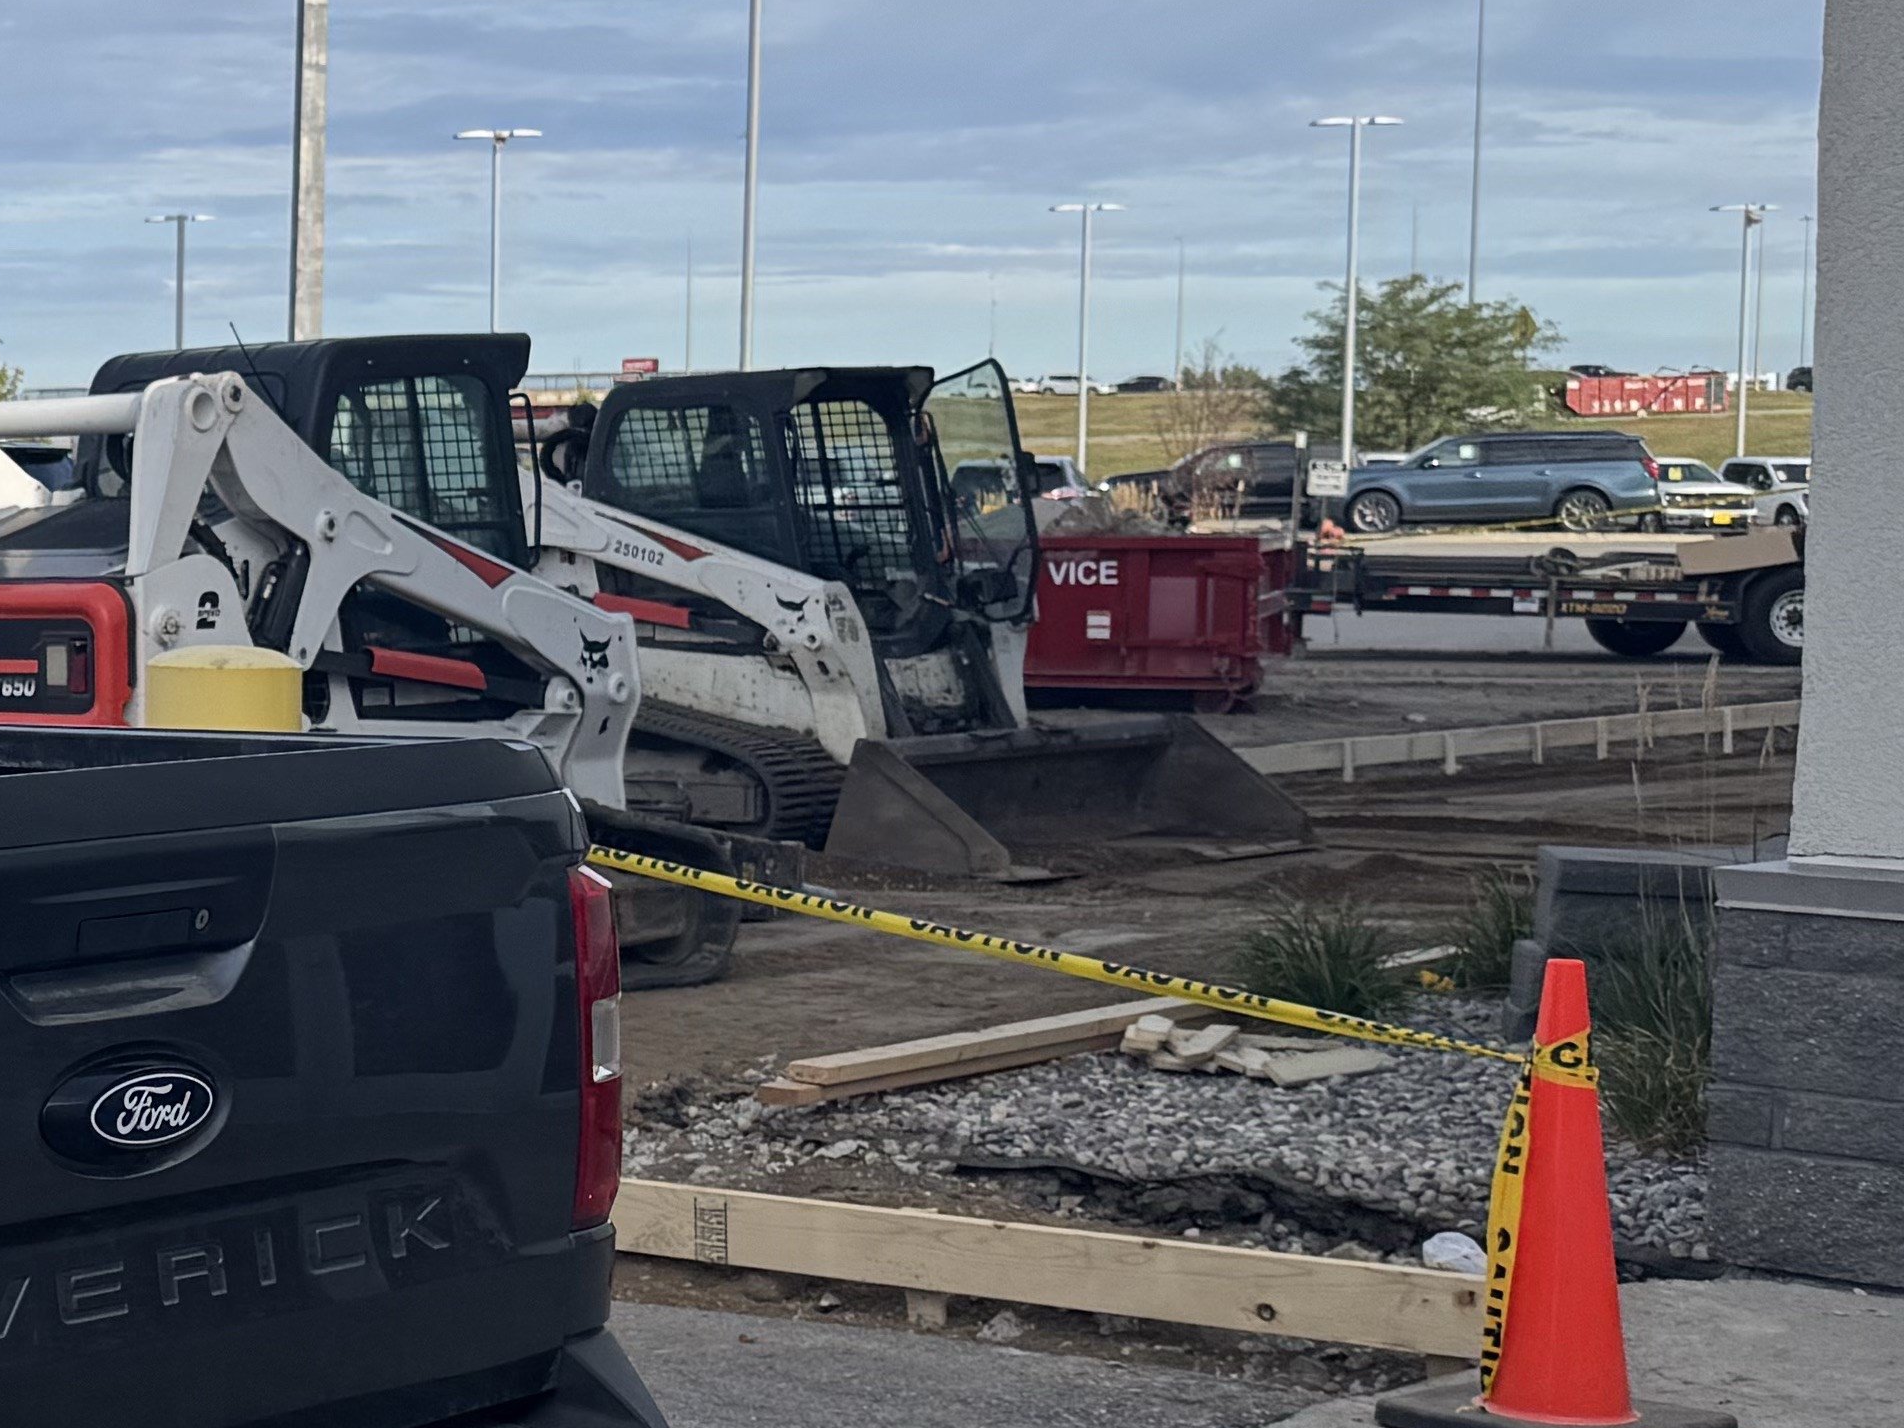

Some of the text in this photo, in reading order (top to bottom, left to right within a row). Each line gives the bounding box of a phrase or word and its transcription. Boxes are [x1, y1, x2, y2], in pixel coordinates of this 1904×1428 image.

[614, 539, 664, 566] 250102
[1048, 560, 1119, 586] VICE
[116, 1083, 192, 1135] Ford
